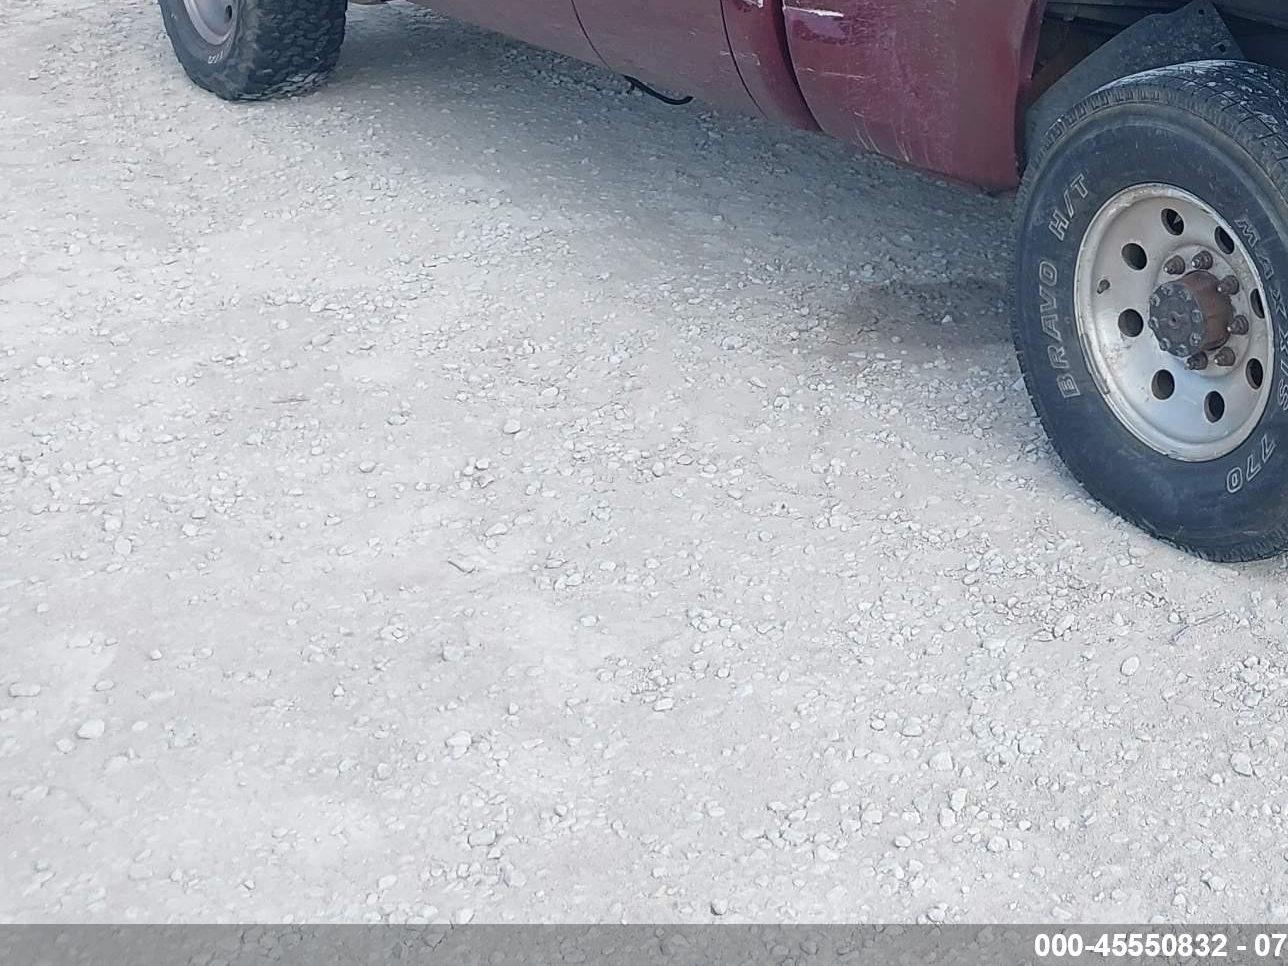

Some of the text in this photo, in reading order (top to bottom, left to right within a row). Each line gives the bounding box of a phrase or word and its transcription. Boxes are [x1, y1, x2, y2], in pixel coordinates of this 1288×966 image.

[1039, 173, 1089, 399] BRAVO H/T
[1226, 433, 1276, 494] 770
